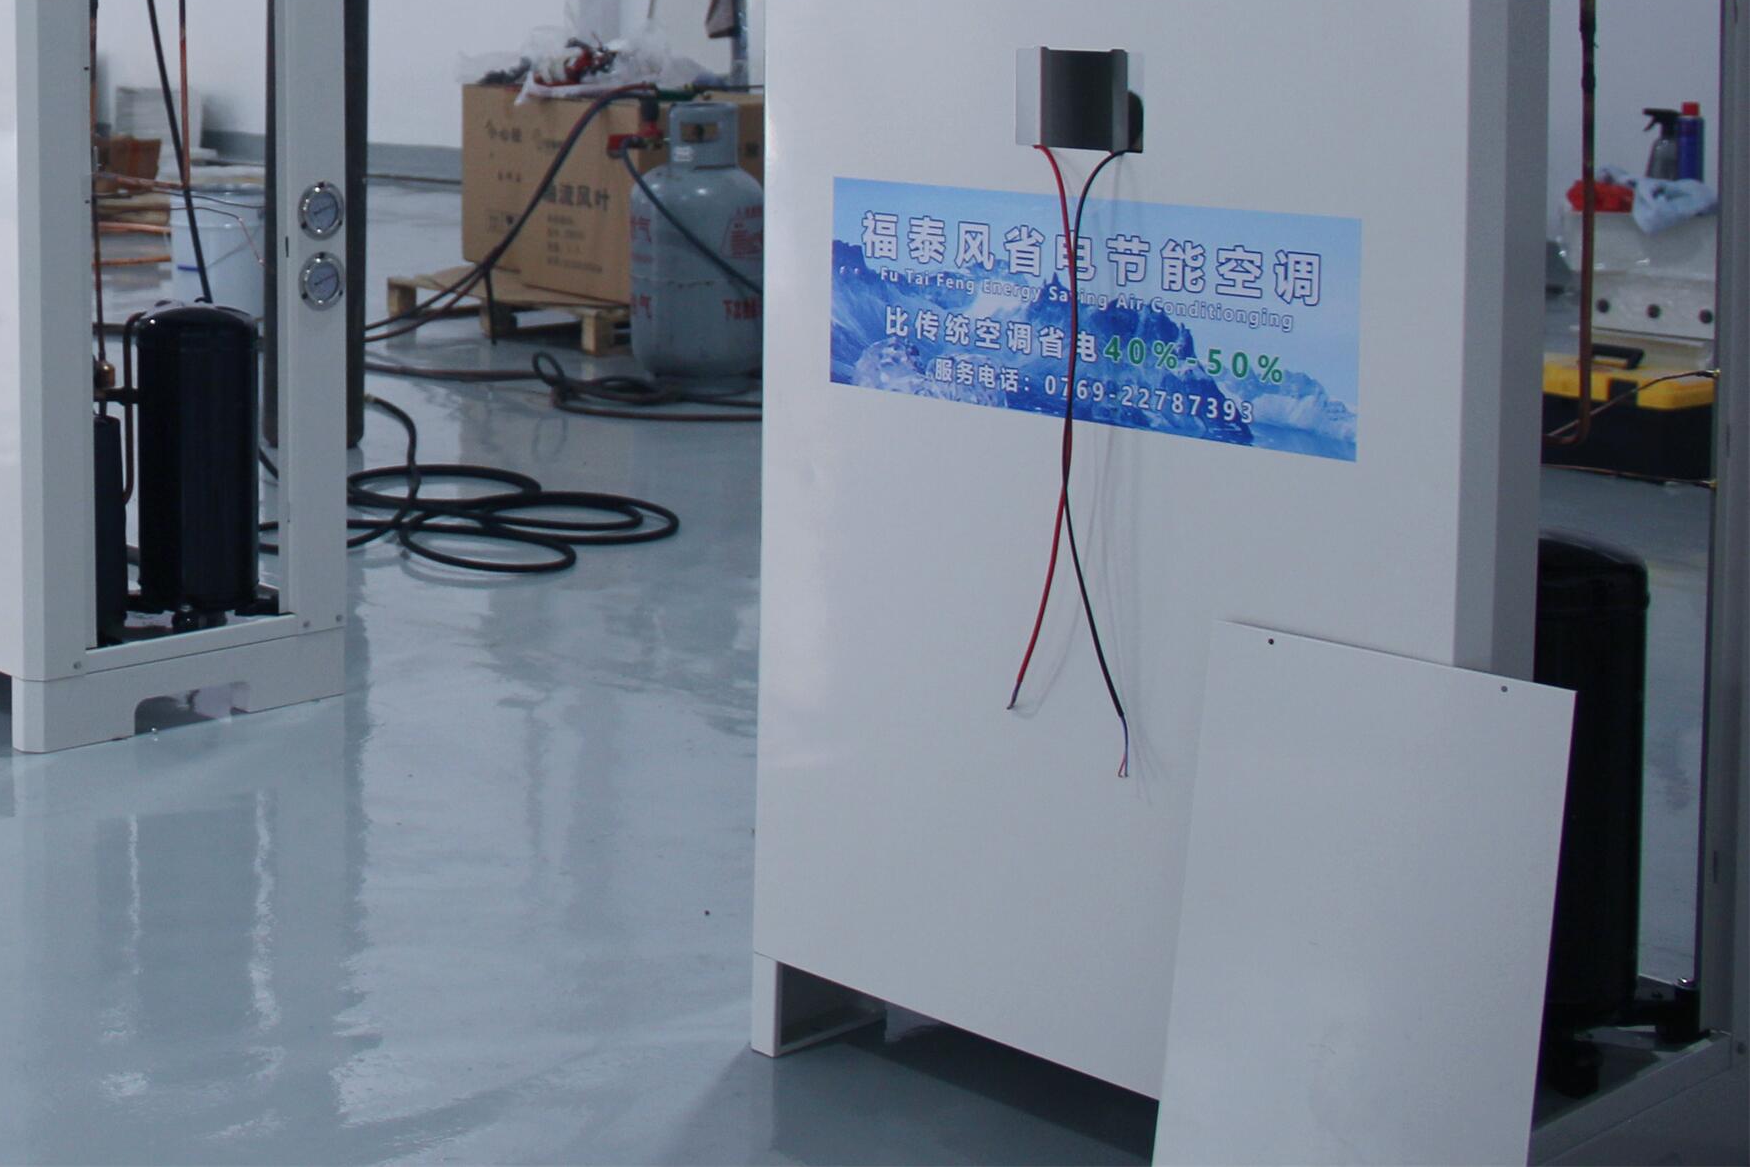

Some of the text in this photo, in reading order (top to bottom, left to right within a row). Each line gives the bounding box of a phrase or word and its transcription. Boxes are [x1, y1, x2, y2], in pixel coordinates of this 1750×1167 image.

[861, 210, 1321, 306] 福泰风省电节能空调
[880, 266, 1294, 333] Fu Tai Feng Energy Saing Air Conditionging
